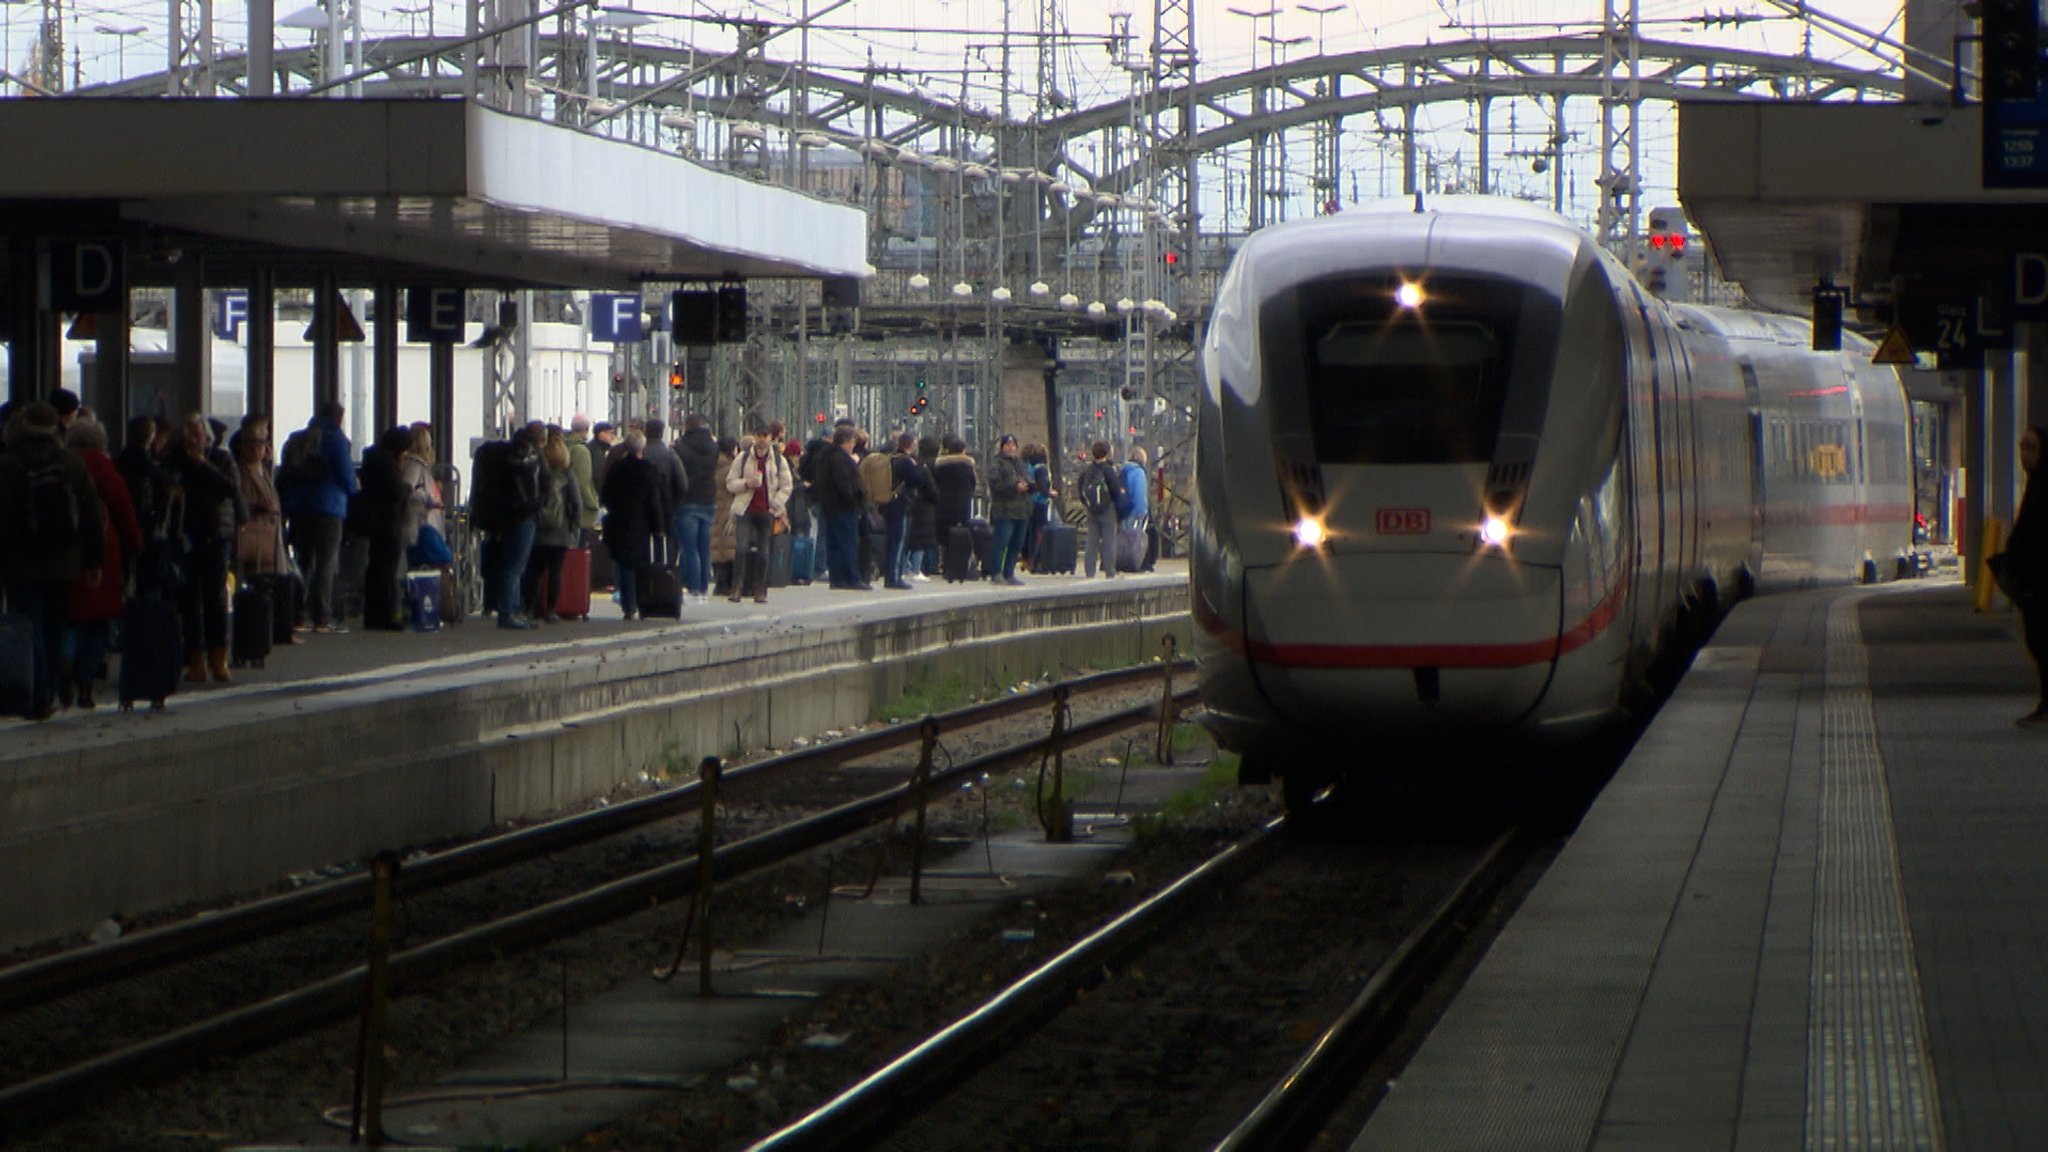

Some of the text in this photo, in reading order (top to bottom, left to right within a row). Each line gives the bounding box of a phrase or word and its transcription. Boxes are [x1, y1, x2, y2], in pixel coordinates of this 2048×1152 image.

[76, 244, 113, 295] D
[2016, 252, 2048, 304] D
[226, 296, 248, 332] F
[431, 287, 457, 329] E
[613, 298, 635, 334] F
[1937, 317, 1967, 349] 24
[1382, 510, 1424, 530] DB
